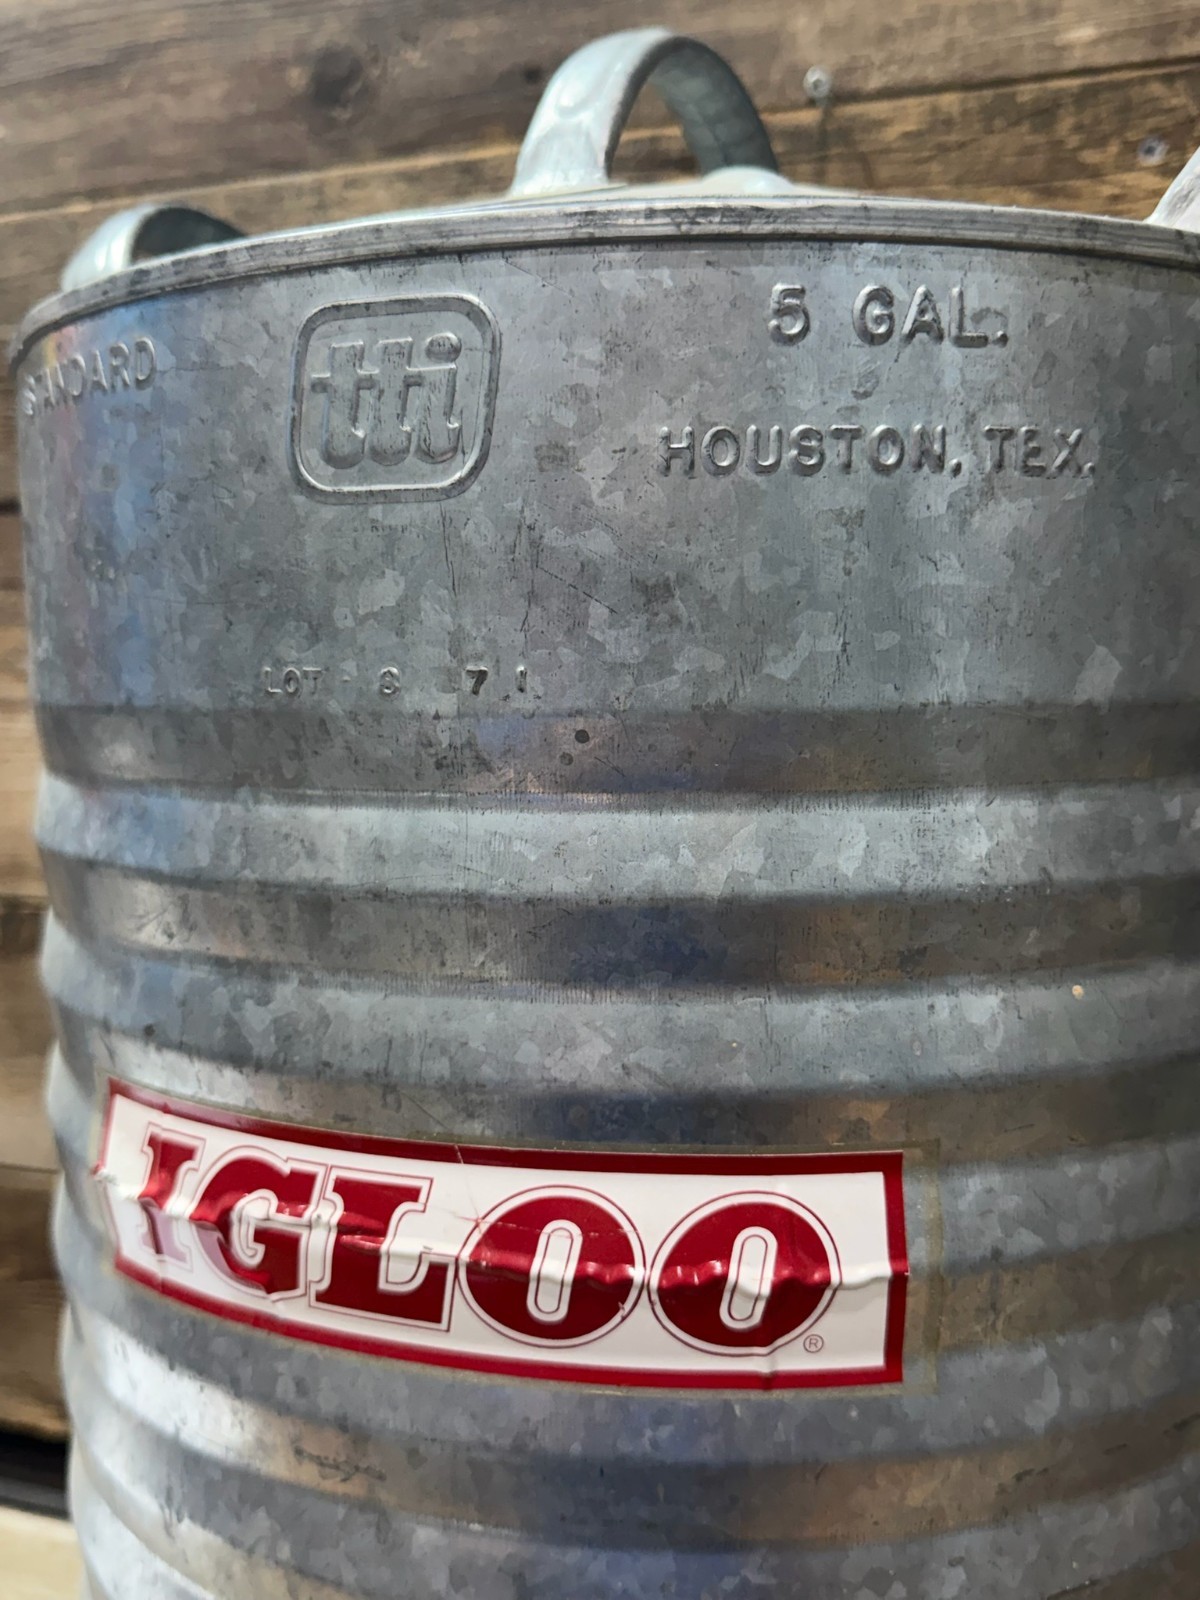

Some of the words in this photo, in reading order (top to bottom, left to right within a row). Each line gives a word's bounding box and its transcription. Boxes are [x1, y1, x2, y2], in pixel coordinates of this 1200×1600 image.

[767, 283, 810, 346] 5
[852, 284, 1009, 348] GAL.
[984, 423, 1096, 478] TEX.
[262, 665, 323, 695] LOT
[141, 1123, 842, 1357] IGLOO
